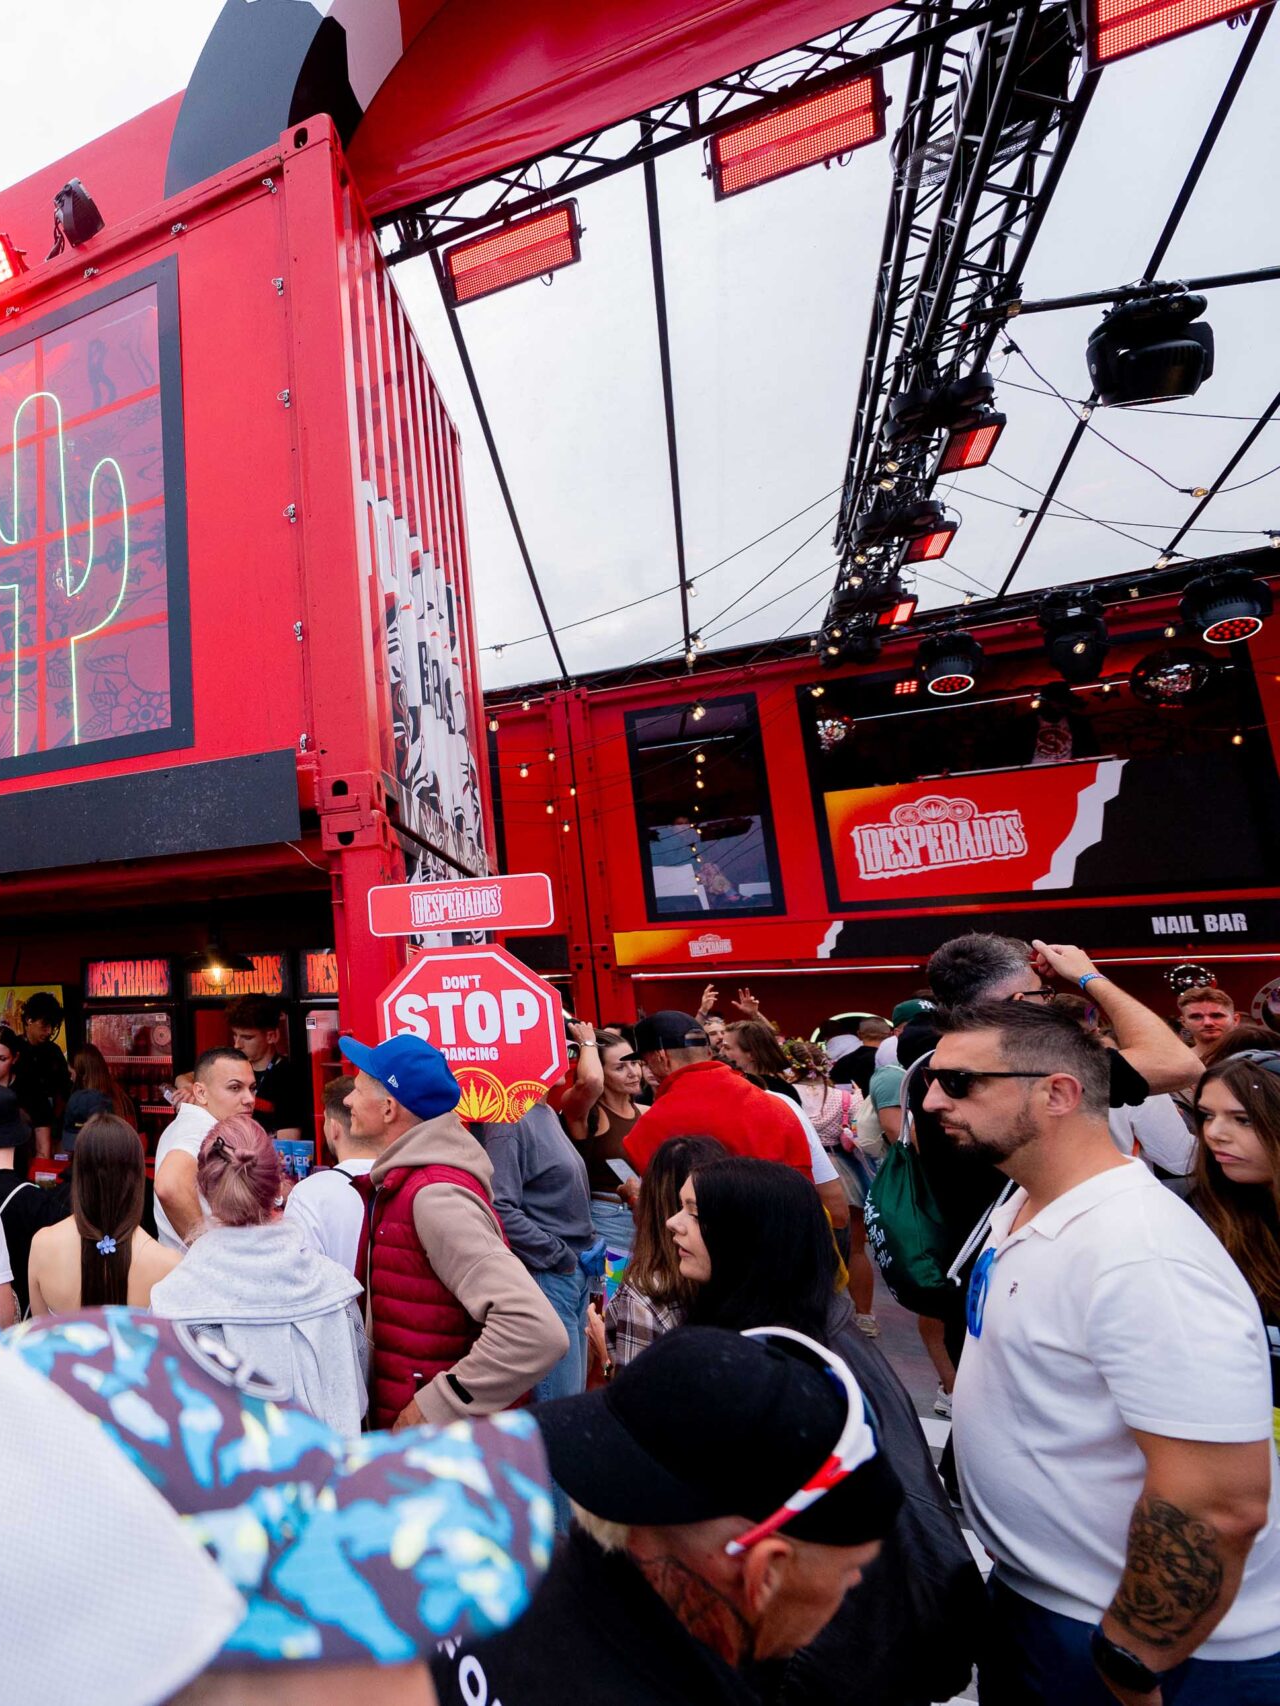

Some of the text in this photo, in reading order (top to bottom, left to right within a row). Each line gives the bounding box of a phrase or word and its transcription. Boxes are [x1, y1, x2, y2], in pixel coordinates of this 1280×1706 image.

[858, 811, 1025, 875] DESPERADOS
[412, 888, 501, 926] DESPERADOS
[1151, 912, 1248, 935] NAIL BAR
[87, 959, 169, 997] DESPERADOS
[442, 974, 481, 990] DON'T
[395, 989, 540, 1046] STOP
[440, 1046, 499, 1061] DANCING
